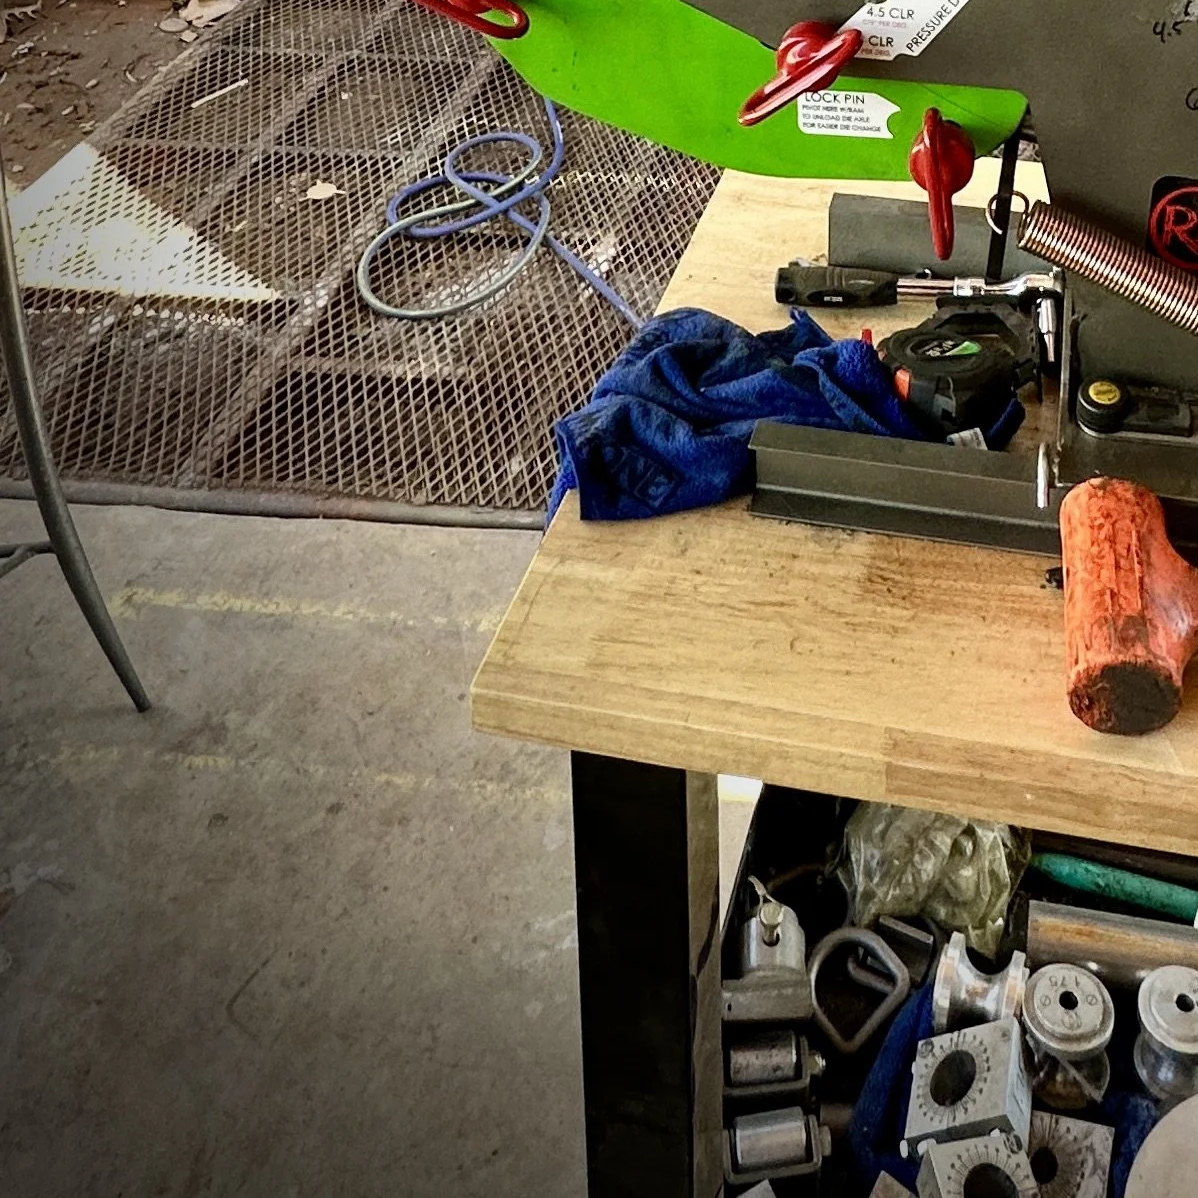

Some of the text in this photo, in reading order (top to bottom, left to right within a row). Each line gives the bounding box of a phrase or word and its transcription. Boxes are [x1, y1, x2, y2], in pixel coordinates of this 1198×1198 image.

[867, 6, 914, 20] 4.5 CLR
[906, 4, 952, 52] PRESSURE
[868, 35, 894, 47] CLR
[805, 92, 865, 104] LOCK PIN
